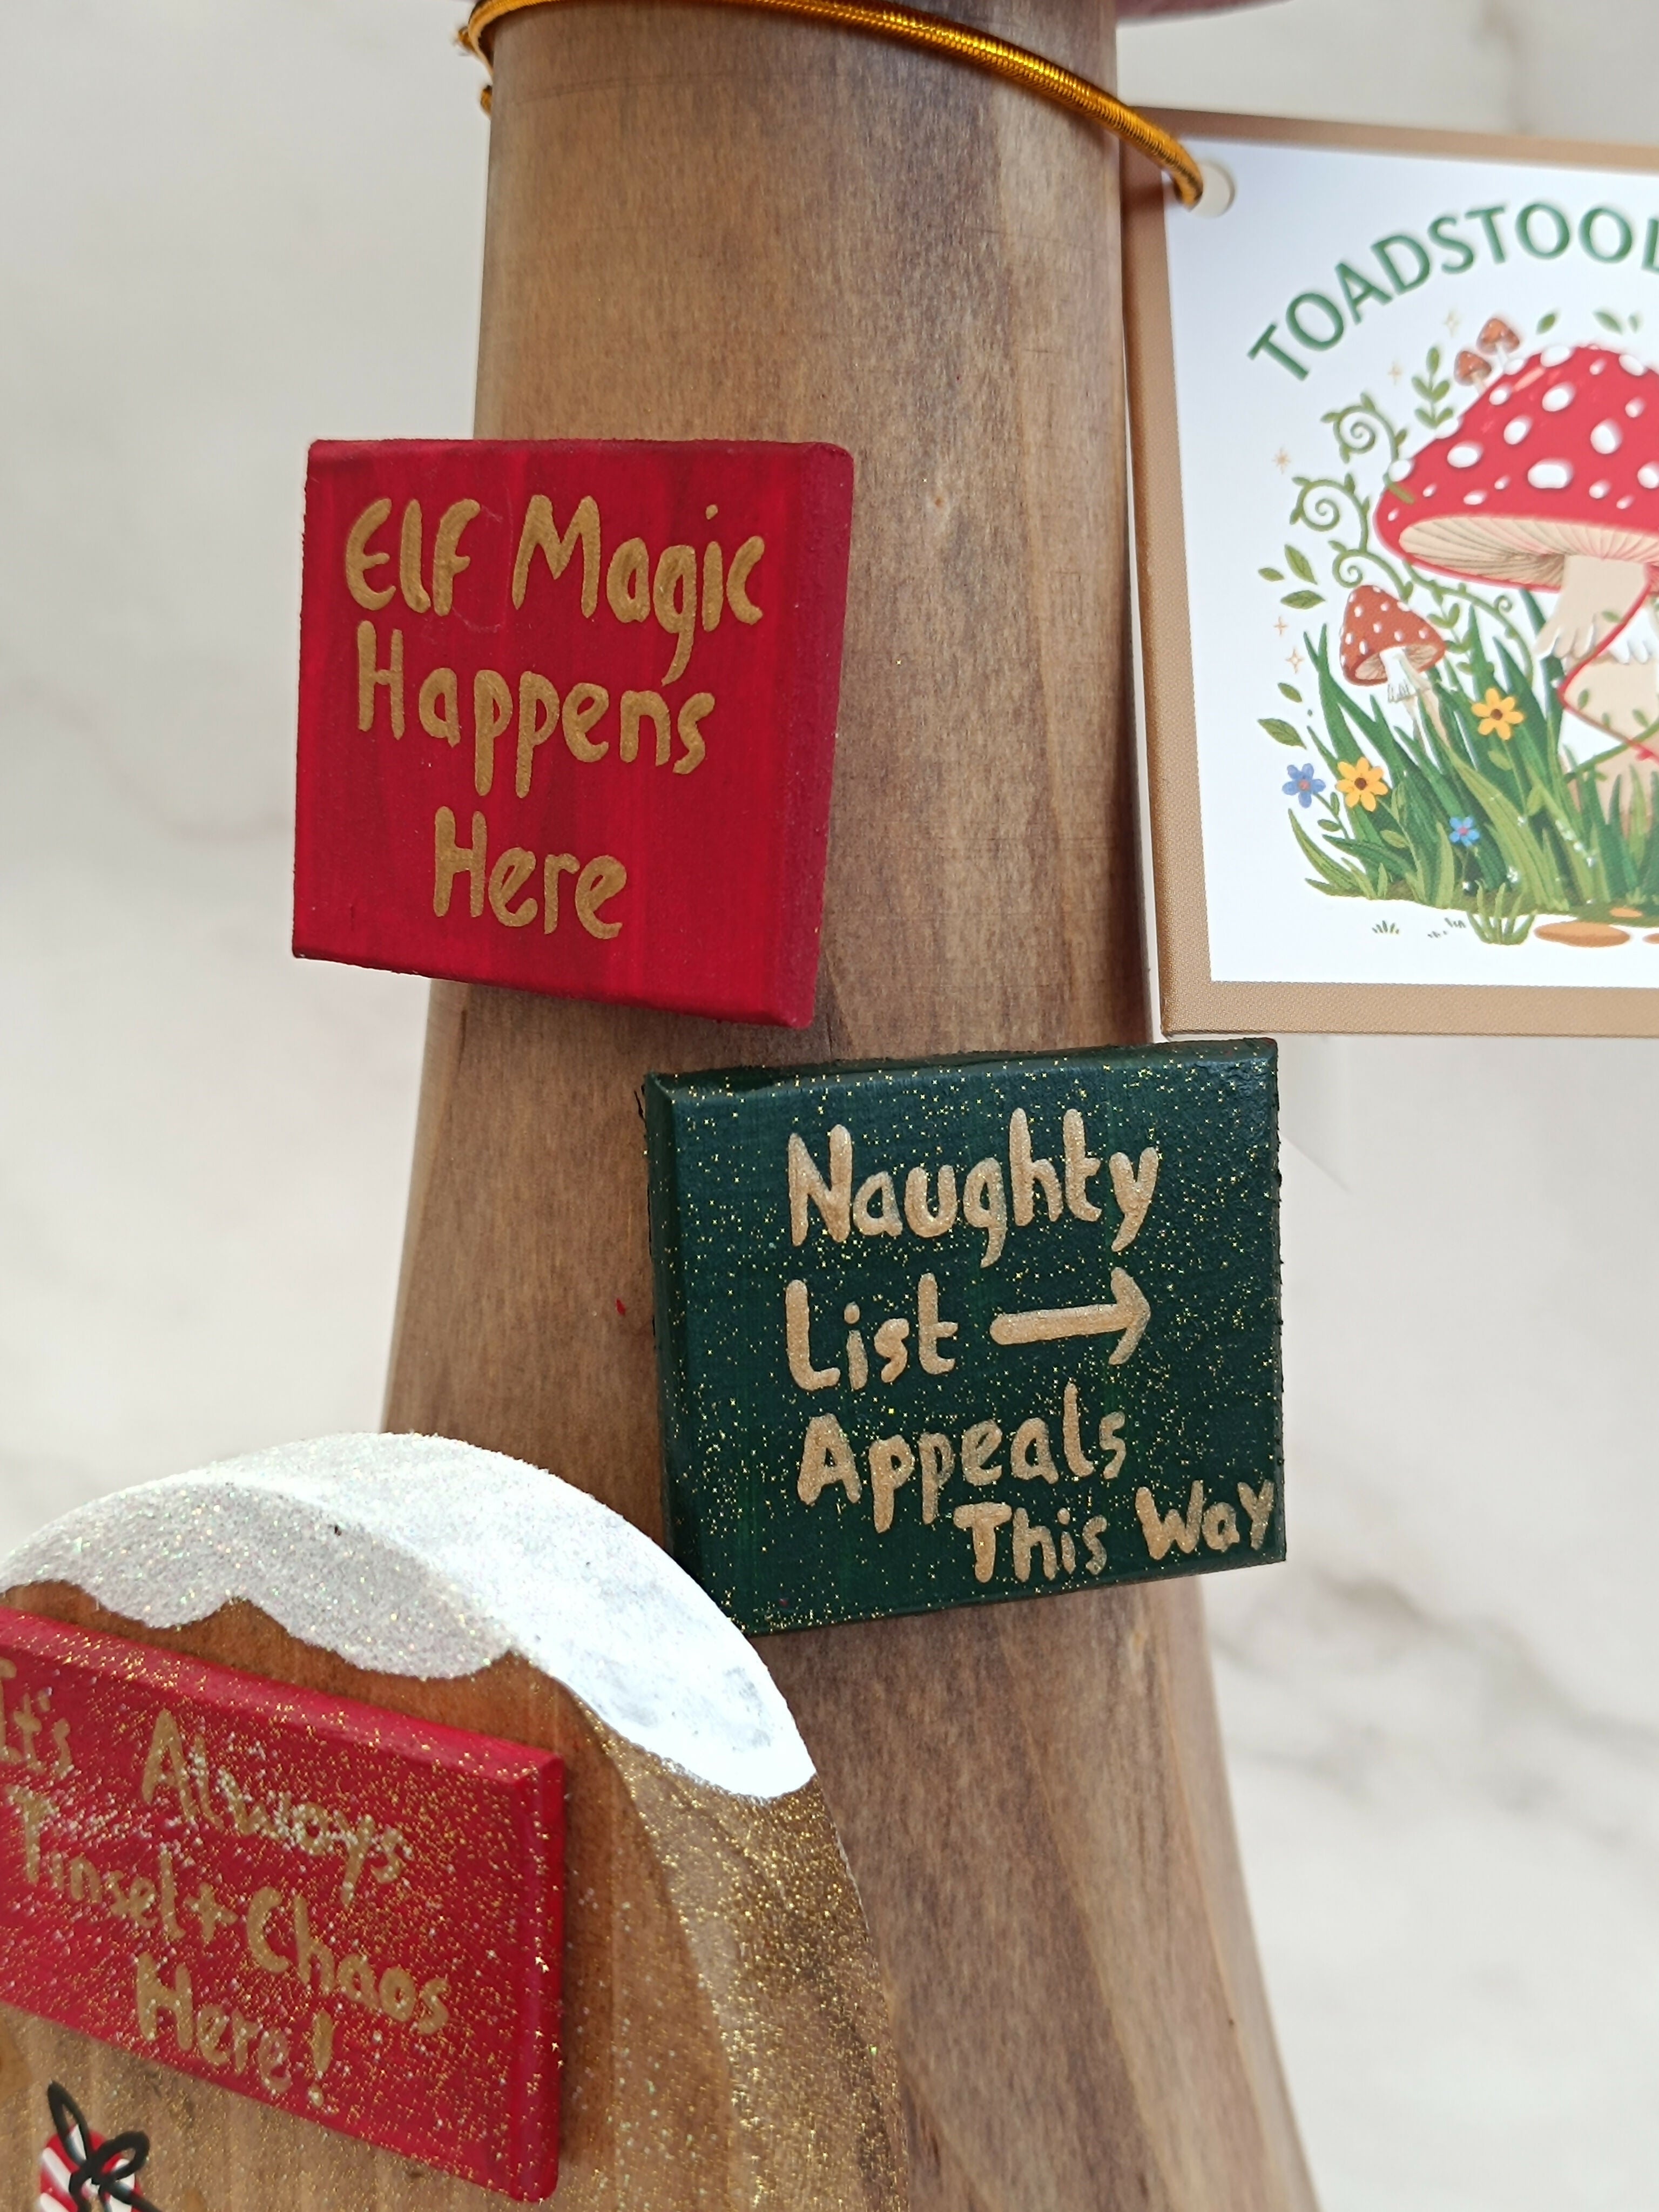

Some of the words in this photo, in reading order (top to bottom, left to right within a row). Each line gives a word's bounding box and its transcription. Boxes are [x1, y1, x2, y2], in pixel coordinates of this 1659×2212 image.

[511, 495, 765, 686] Magic
[357, 621, 716, 798] Happens
[433, 806, 628, 940] Here
[787, 1108, 1159, 1268] Naughty
[785, 1273, 958, 1391] List
[797, 1382, 1127, 1533] Appeals
[953, 1501, 1108, 1583] This
[141, 1709, 413, 1907] Always
[133, 1952, 336, 2107] Here!
